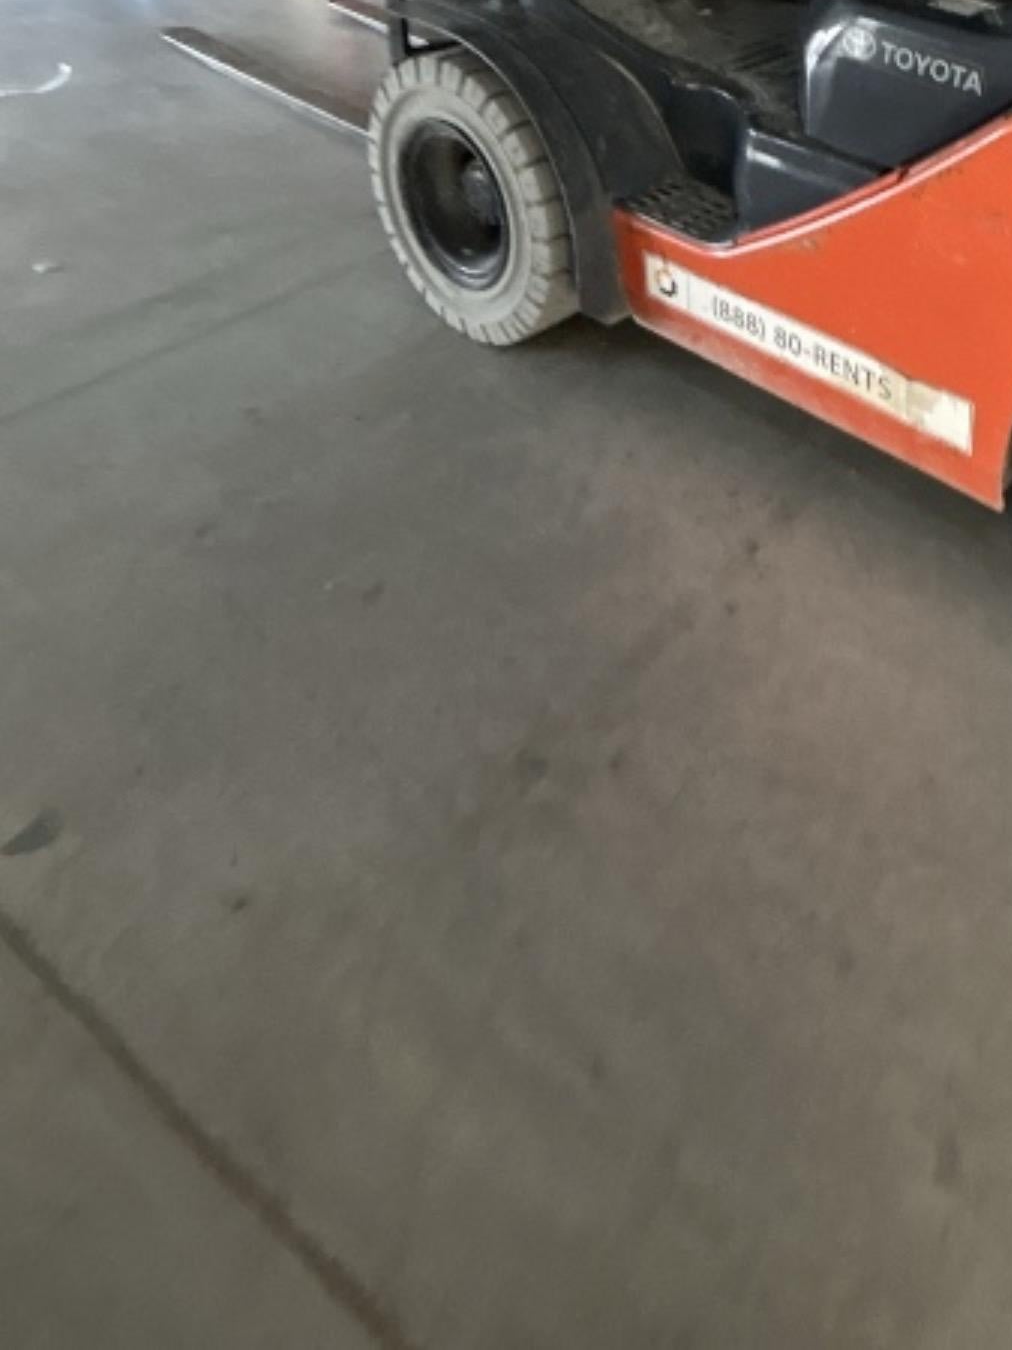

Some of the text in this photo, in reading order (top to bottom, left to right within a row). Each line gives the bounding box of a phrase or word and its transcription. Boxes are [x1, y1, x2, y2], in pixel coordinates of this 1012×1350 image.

[881, 40, 983, 98] TOYOTA
[712, 295, 893, 402] (888) 80-RENTS
